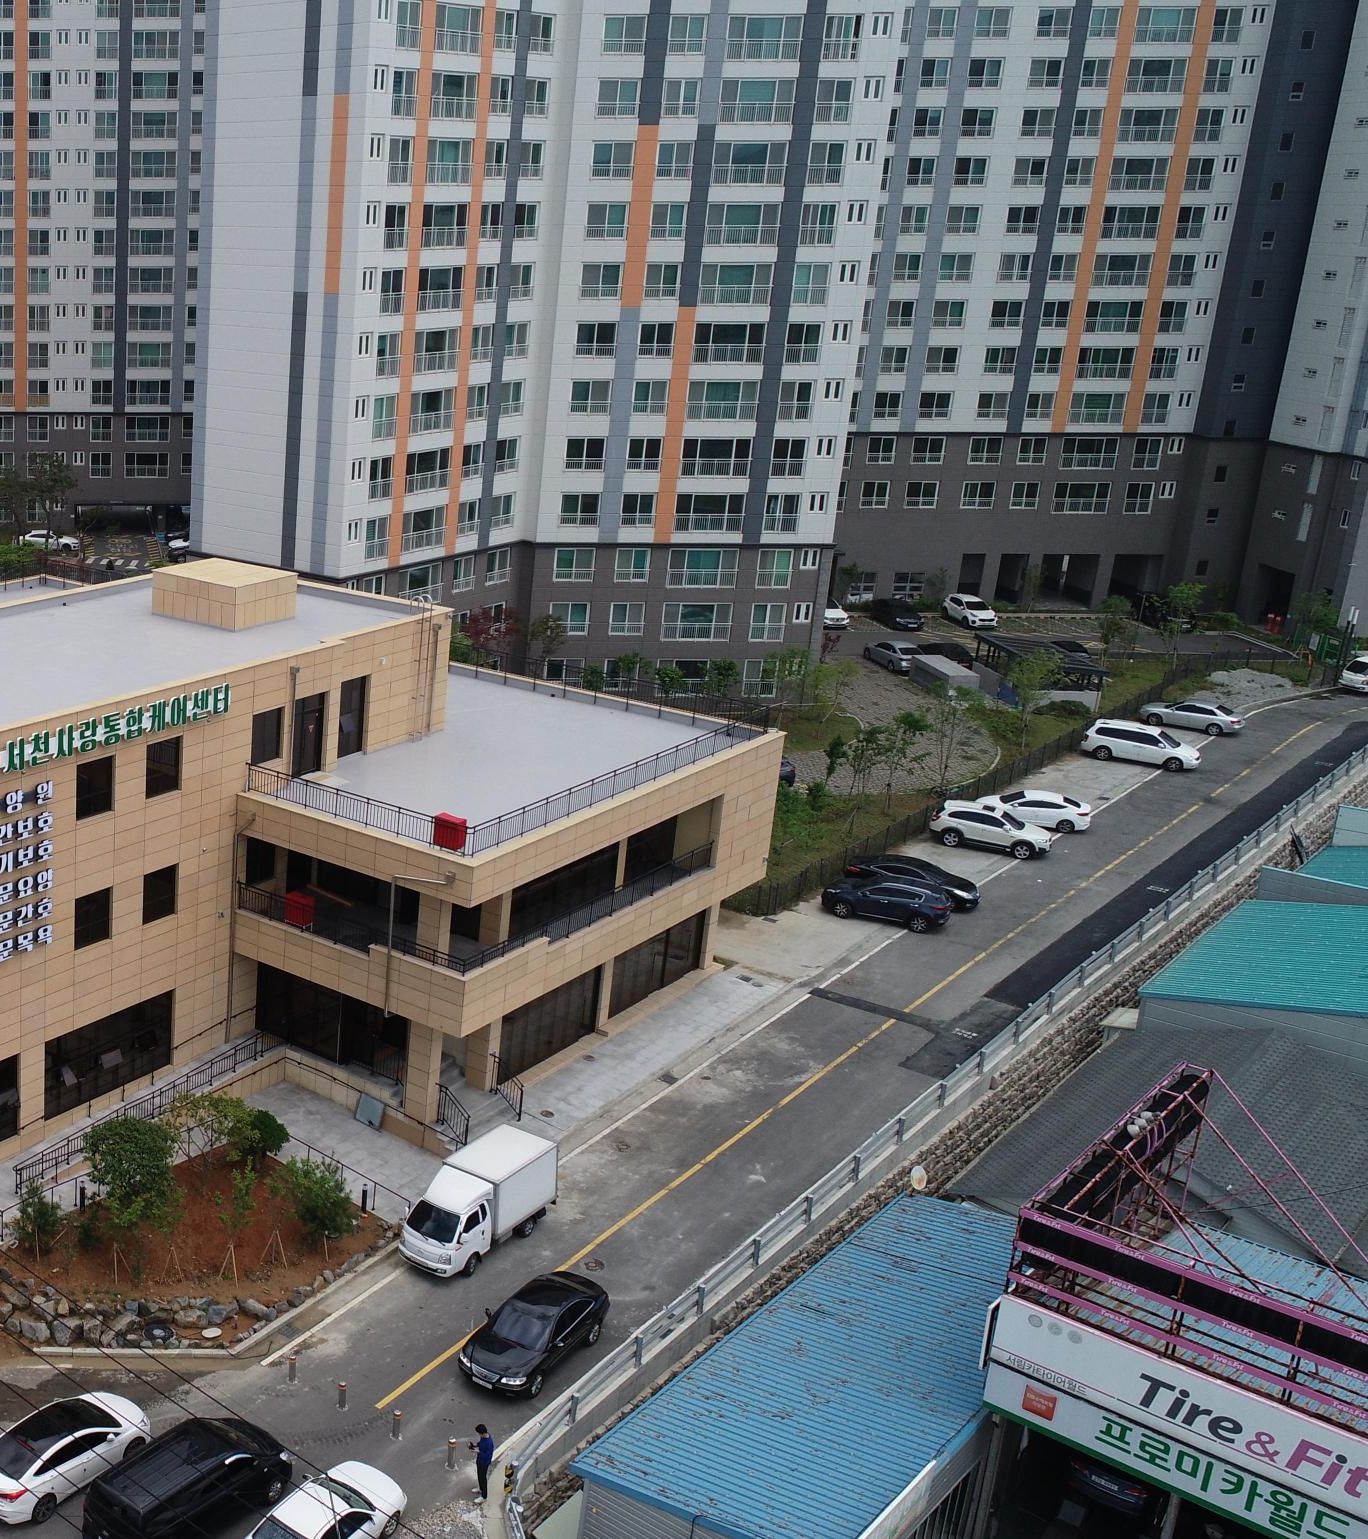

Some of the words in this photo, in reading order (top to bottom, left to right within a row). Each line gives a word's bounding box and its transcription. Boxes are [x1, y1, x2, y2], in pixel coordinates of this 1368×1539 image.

[3, 683, 232, 774] 서천사랑통합케어센터
[1006, 1354, 1088, 1397] 서림카타이어월드
[1094, 1415, 1350, 1539] 프로미카월드
